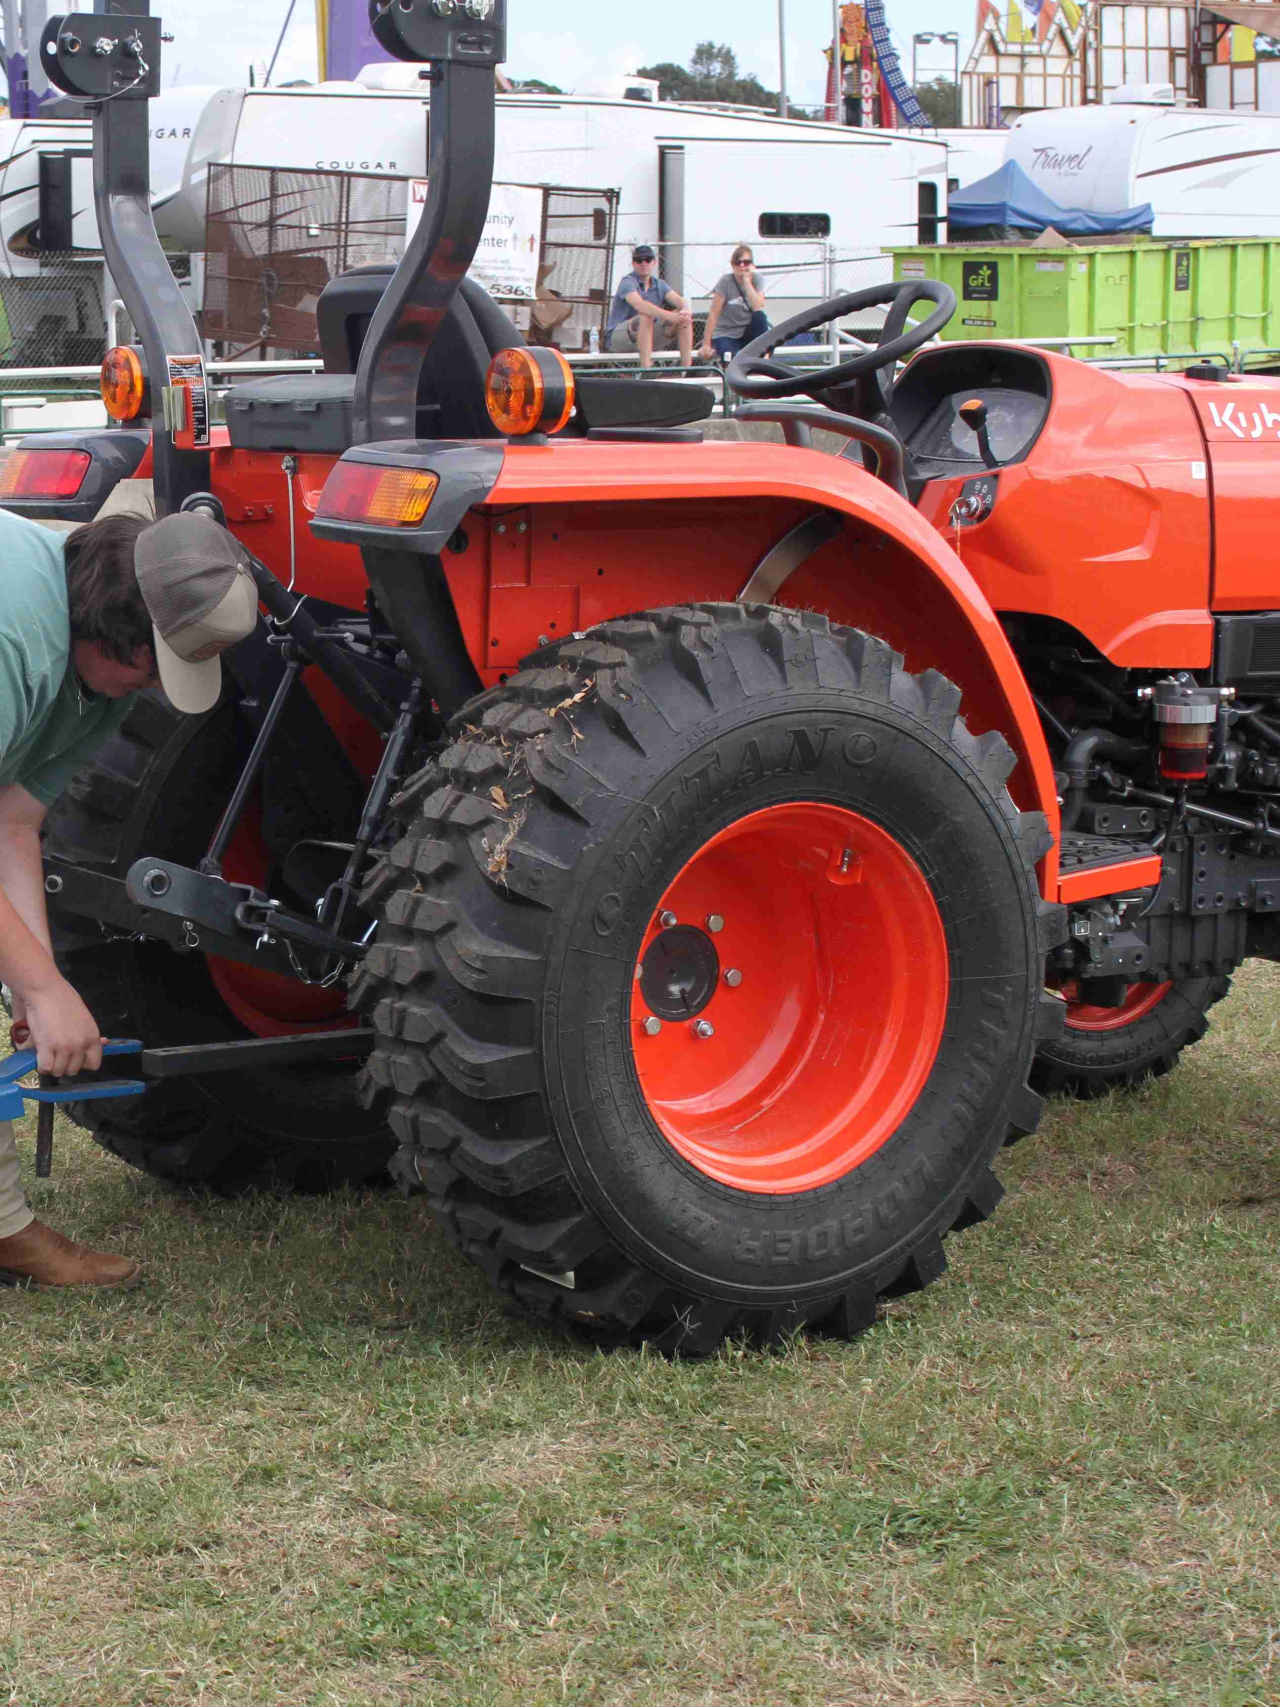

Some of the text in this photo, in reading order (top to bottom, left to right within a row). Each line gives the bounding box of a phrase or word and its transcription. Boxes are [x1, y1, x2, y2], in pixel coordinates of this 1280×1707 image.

[149, 128, 191, 139] GAR
[315, 160, 398, 170] COUGAR
[1031, 144, 1094, 171] Travel
[485, 212, 515, 229] unity
[477, 236, 509, 248] enter
[968, 273, 992, 287] GFL
[1209, 402, 1280, 438] Kub
[614, 724, 837, 878] TITAN
